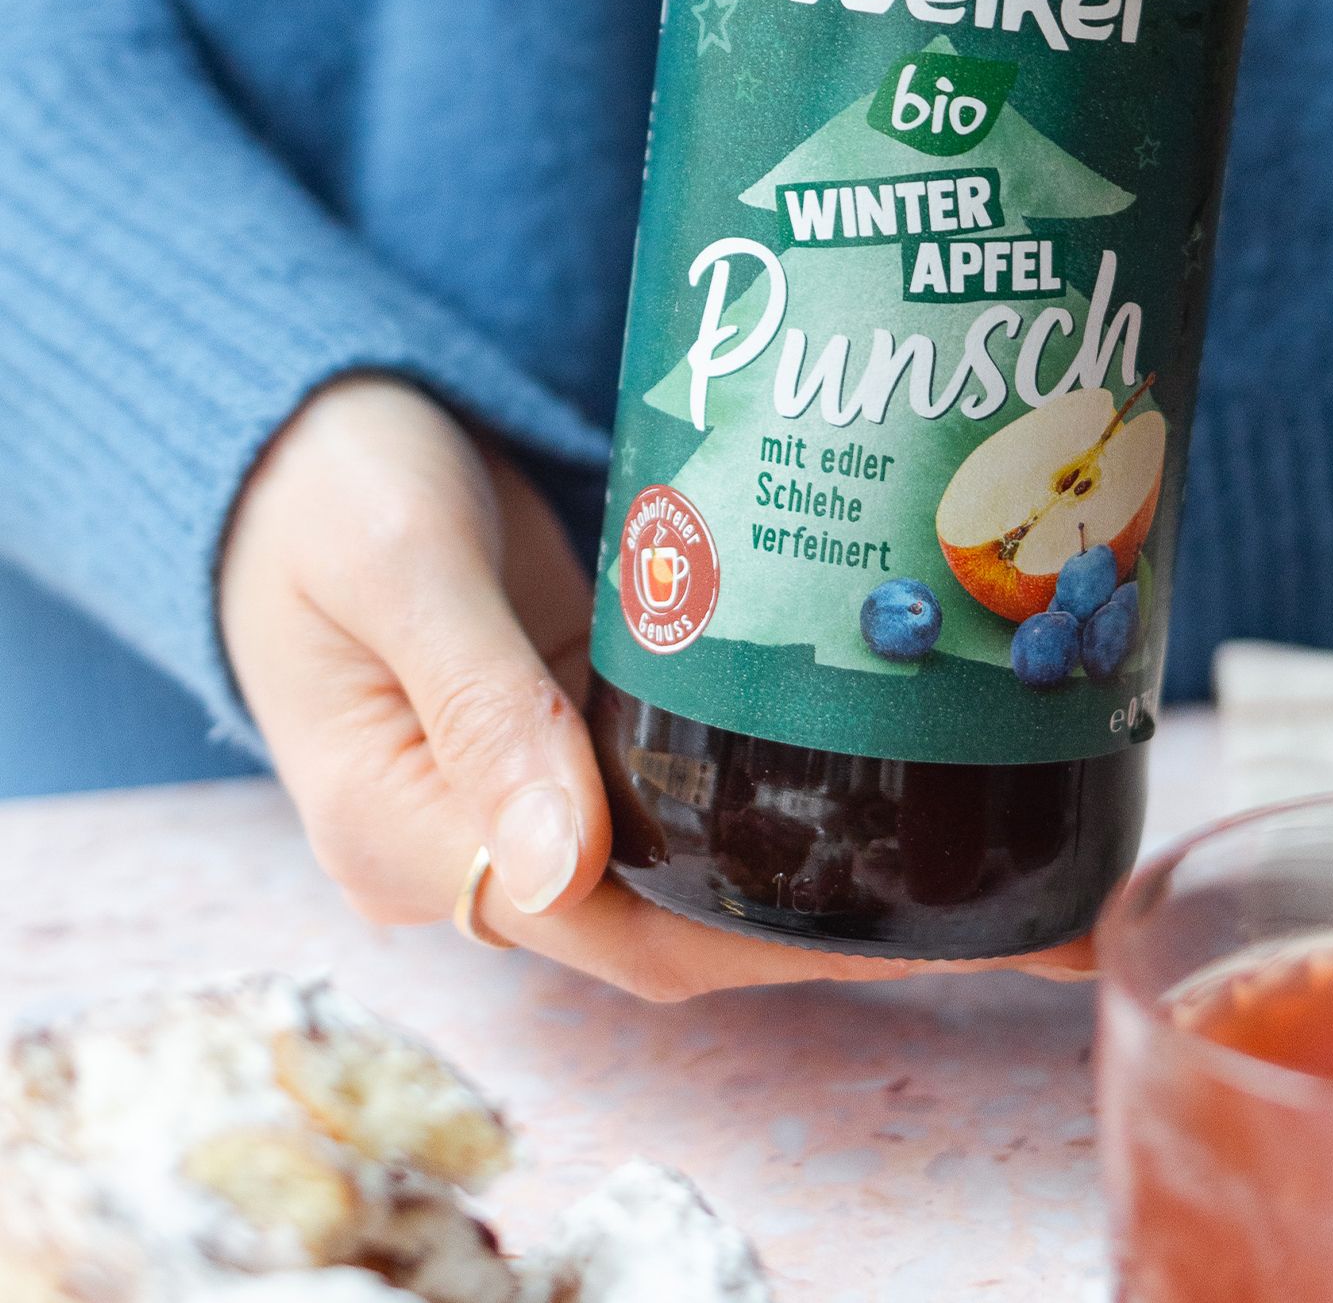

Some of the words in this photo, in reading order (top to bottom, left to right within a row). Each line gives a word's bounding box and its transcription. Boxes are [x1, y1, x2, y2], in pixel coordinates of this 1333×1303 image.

[890, 65, 987, 135] bio
[784, 176, 993, 241] WINTER
[909, 240, 1061, 294] APFEL
[688, 236, 1143, 432] Punsch
[760, 434, 807, 469] mit
[820, 442, 895, 482] edler
[626, 496, 701, 551] alkoholfreier
[755, 471, 863, 523] Schlehe
[750, 522, 891, 572] verfeinert
[638, 611, 693, 642] Genuss
